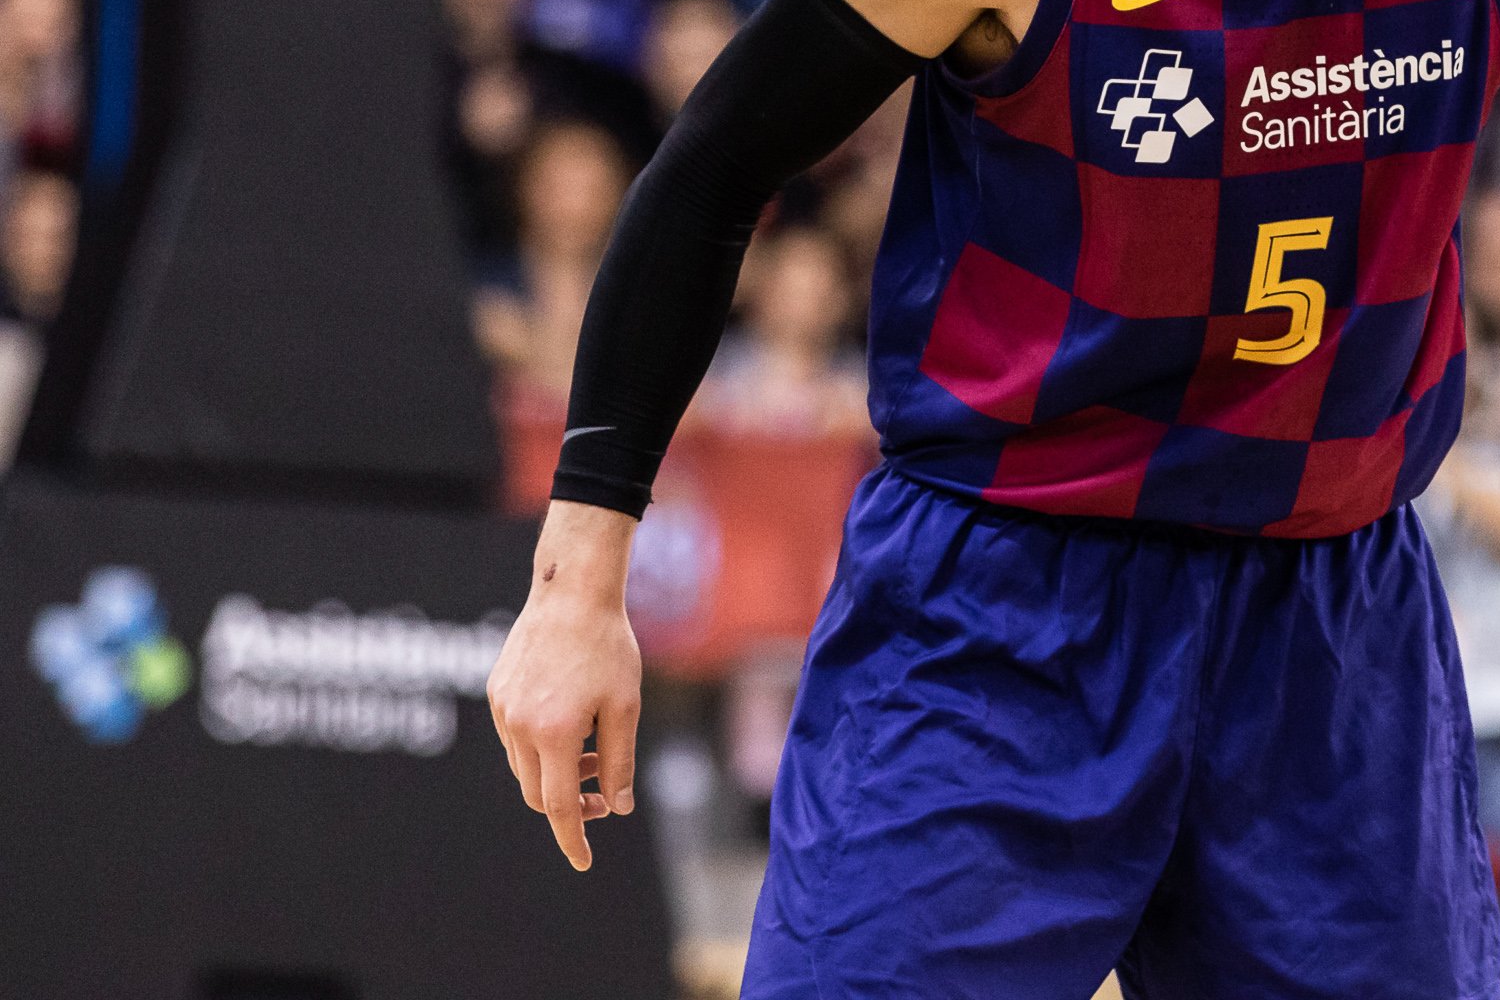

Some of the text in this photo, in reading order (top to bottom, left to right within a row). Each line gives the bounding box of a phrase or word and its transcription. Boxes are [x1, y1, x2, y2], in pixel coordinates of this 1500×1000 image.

[1240, 39, 1465, 108] Assistència
[1240, 96, 1405, 154] Sanitària
[1233, 216, 1334, 366] 5
